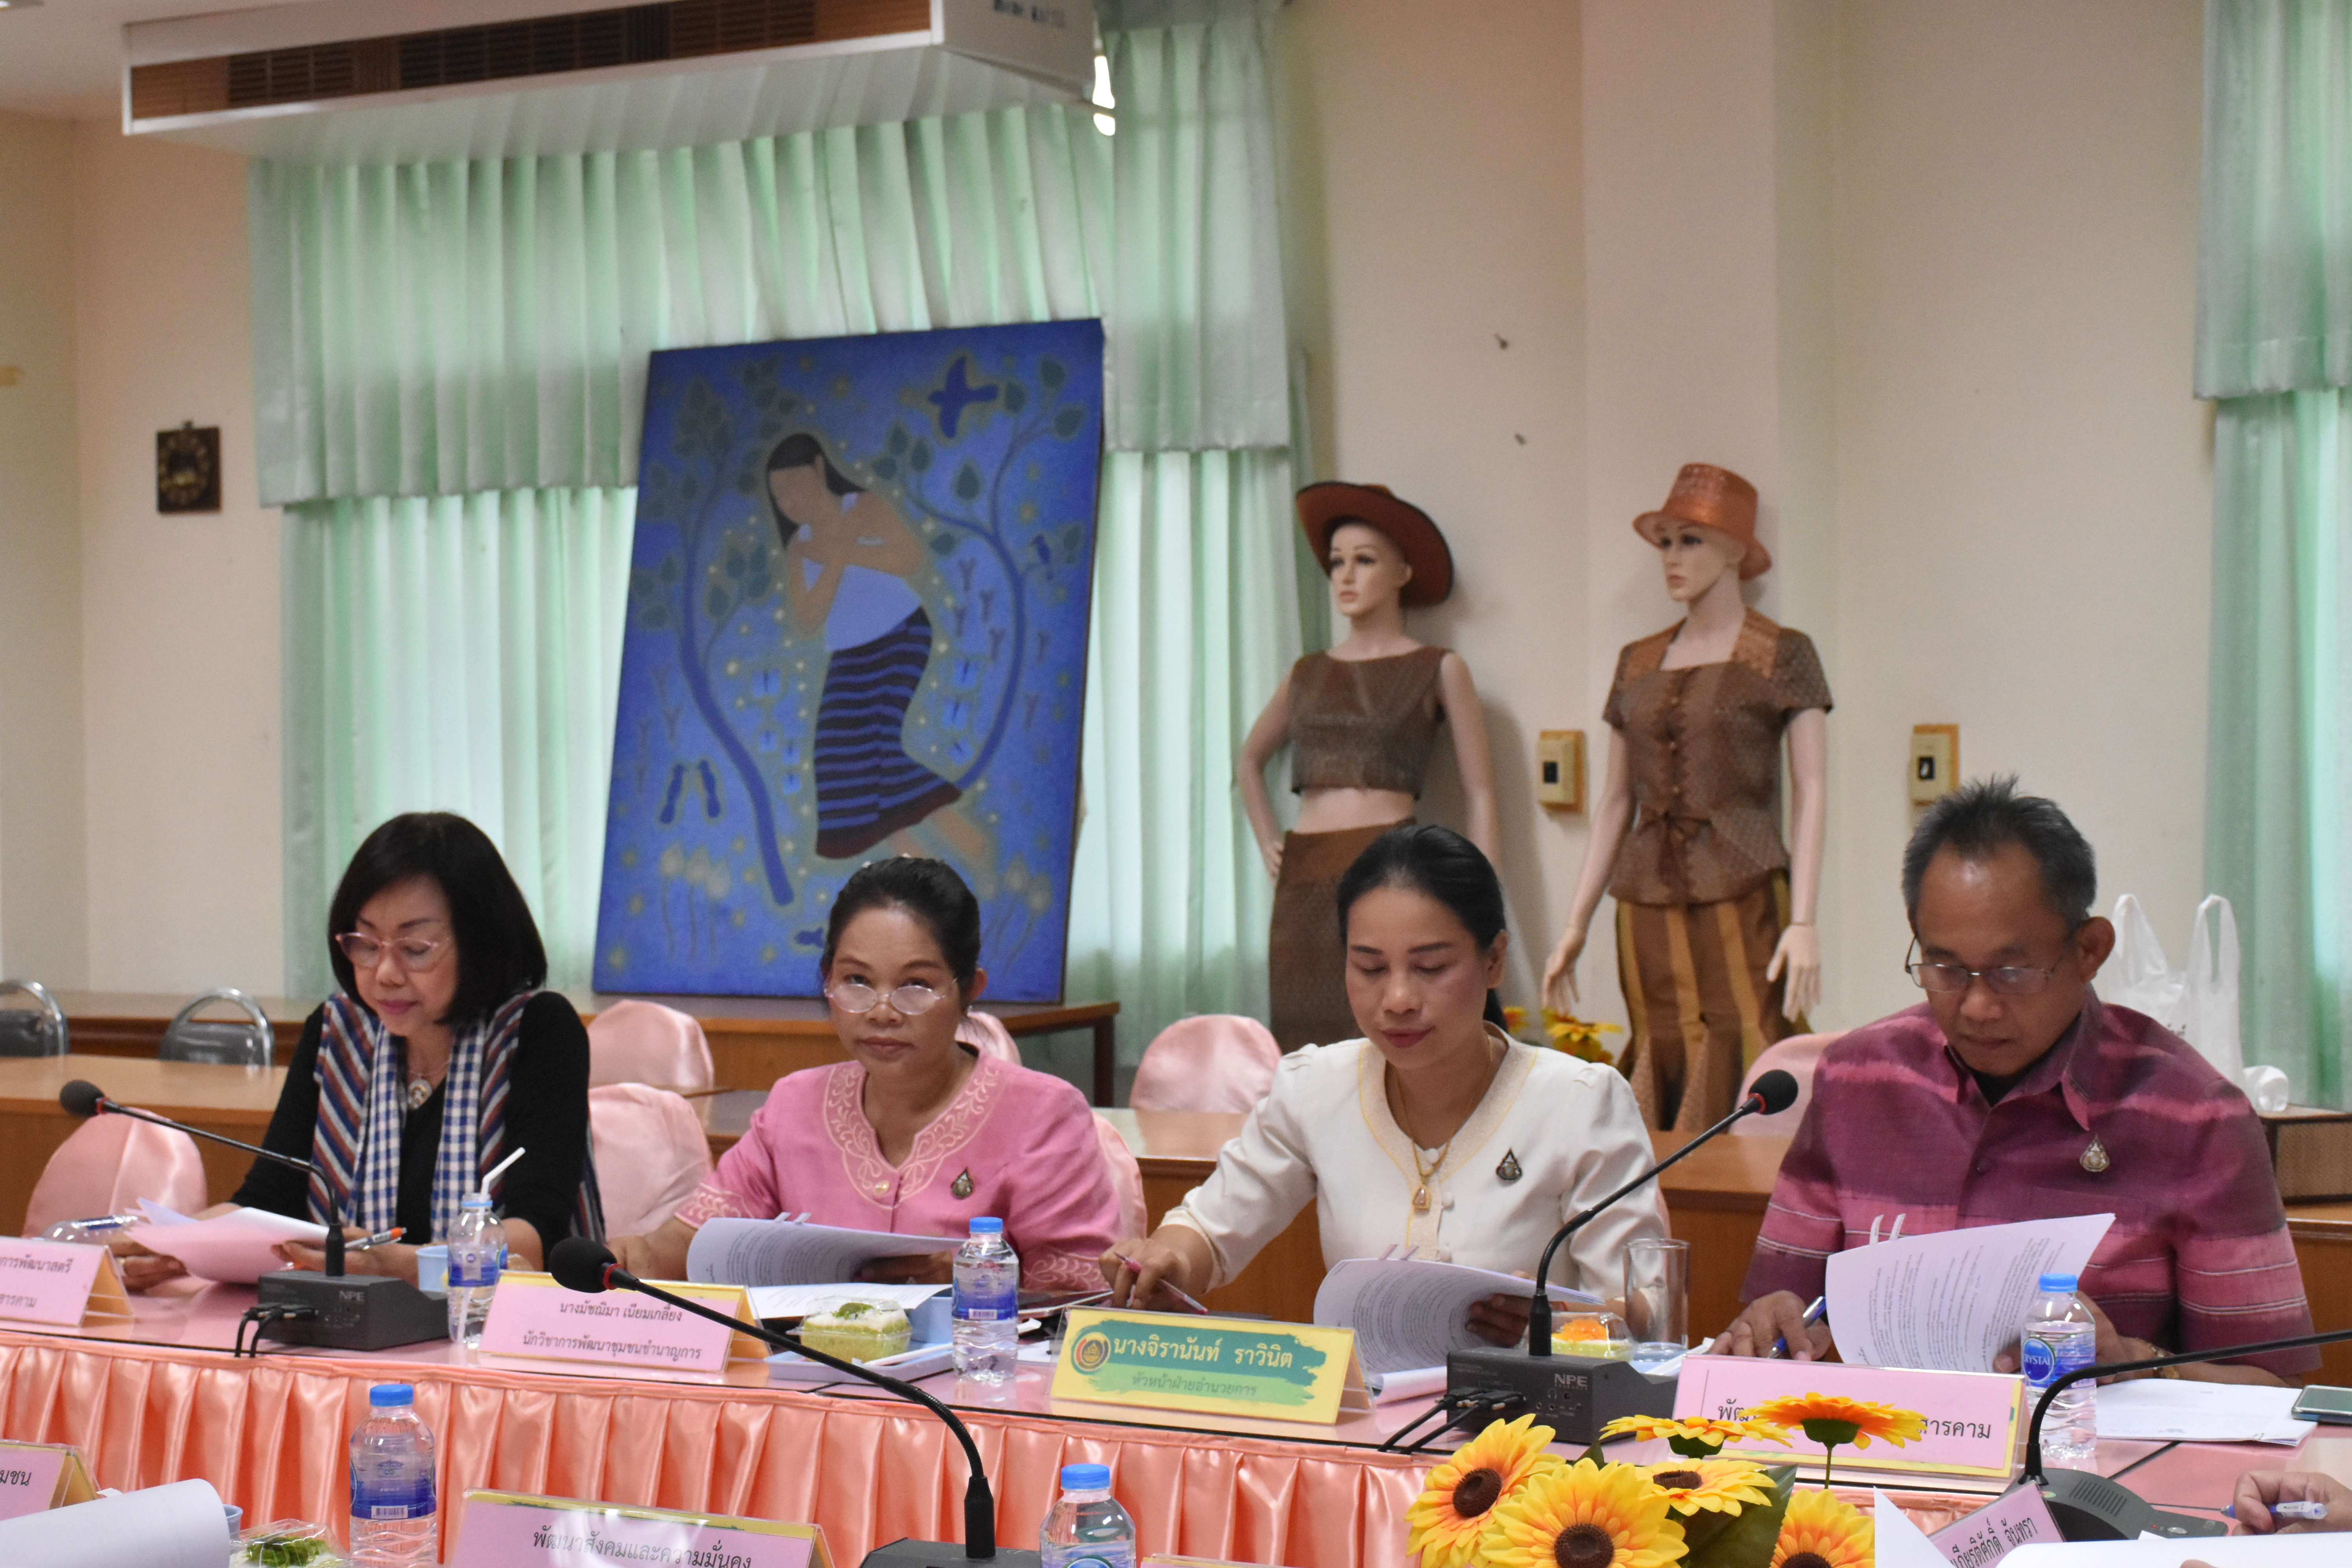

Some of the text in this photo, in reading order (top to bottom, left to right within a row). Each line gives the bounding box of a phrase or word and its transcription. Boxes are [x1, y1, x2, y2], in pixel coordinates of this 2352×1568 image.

[1114, 1334, 1293, 1368] นางจิรานันท์ ราวินิต
[1554, 1373, 1588, 1387] NPE
[2001, 1517, 2038, 1547] จันทรา
